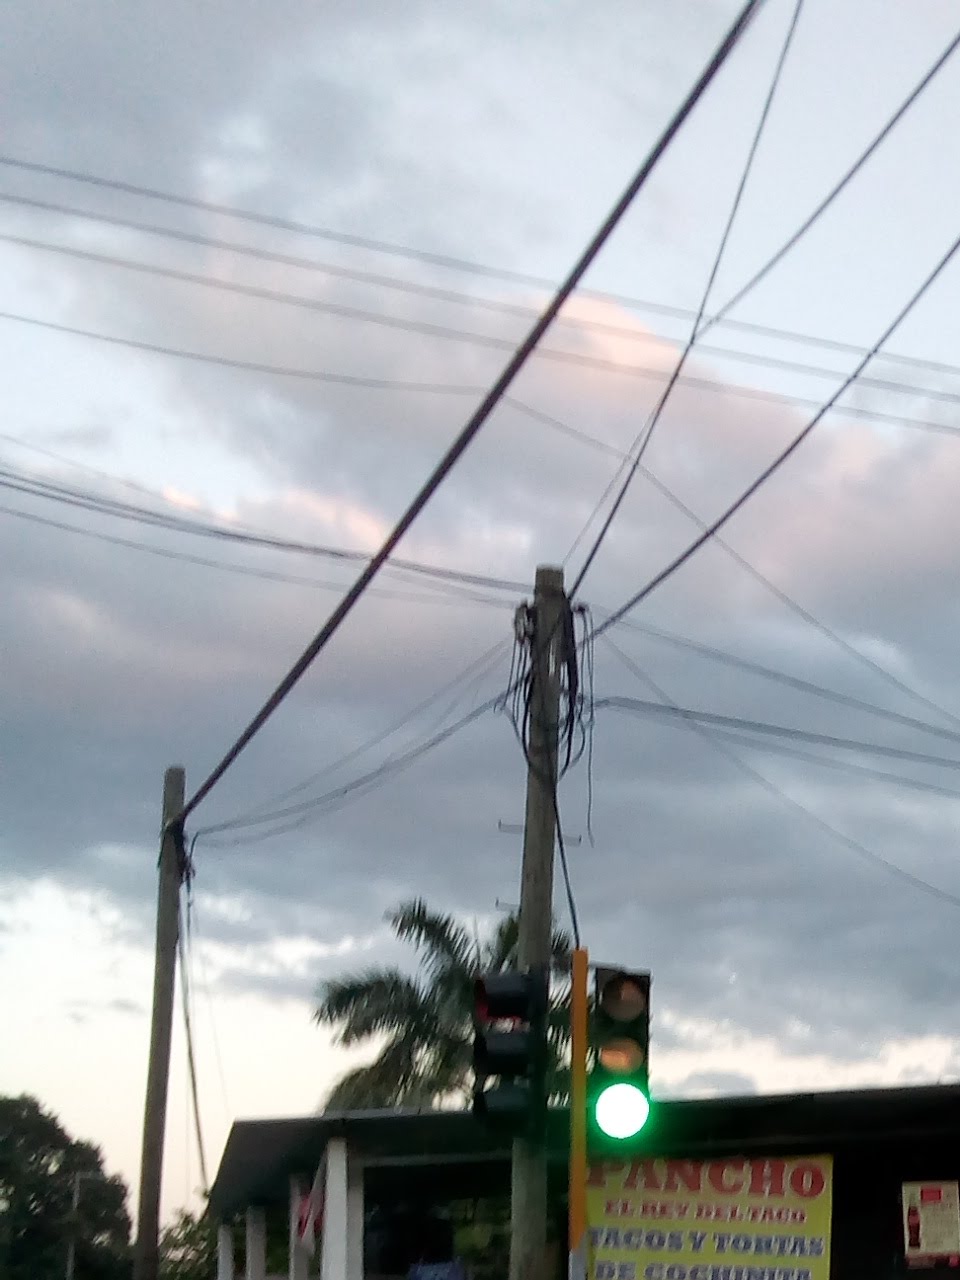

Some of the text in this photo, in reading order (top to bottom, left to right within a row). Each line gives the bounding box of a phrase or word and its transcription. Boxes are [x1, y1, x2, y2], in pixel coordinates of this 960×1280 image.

[587, 1158, 827, 1199] PANCHO
[588, 1226, 825, 1258] TACOS Y TORTAS
